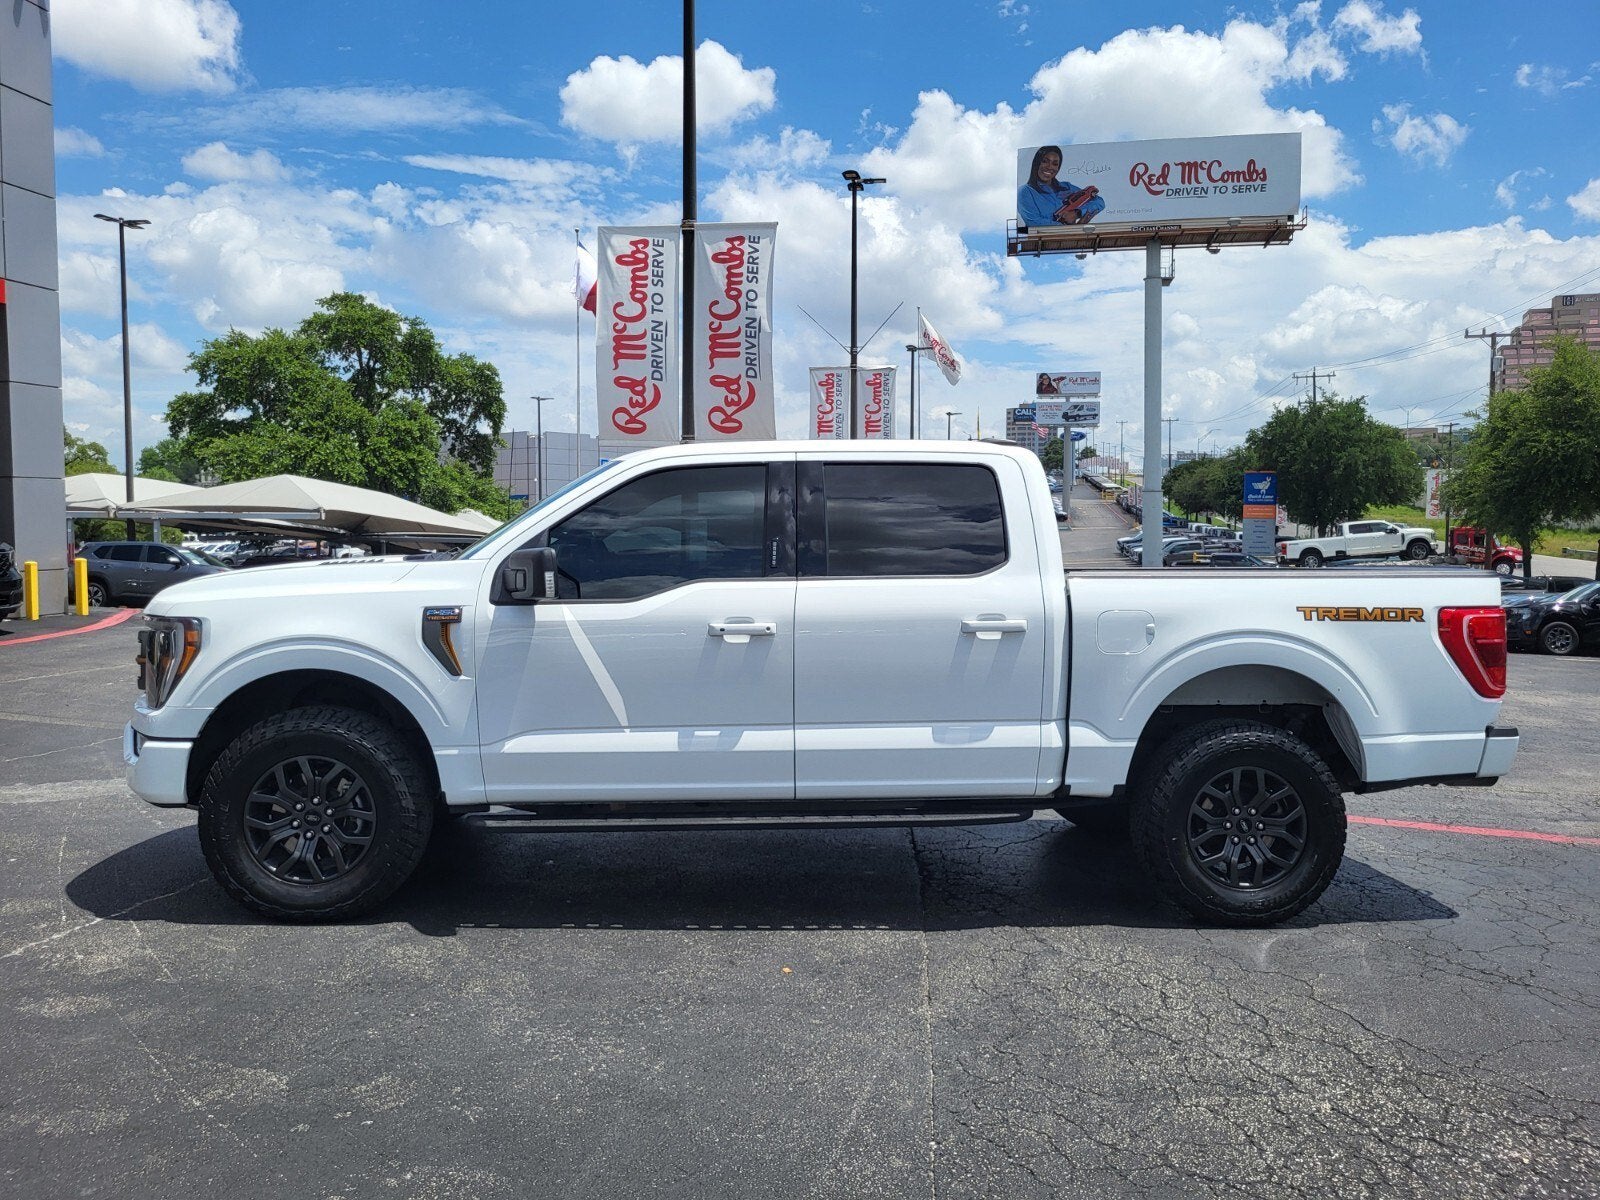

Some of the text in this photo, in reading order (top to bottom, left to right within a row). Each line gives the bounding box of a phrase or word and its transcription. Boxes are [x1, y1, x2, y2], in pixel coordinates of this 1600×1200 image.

[1129, 162, 1171, 196] Red
[1174, 158, 1268, 185] McCombs
[1166, 183, 1267, 197] DRIVEN TO SERVE
[612, 238, 661, 434] Red McCombs
[651, 239, 664, 382] DRIVEN TO SERVE
[708, 235, 756, 434] Red McCombs
[745, 235, 760, 379] DRIVEN TO SERVE
[817, 372, 835, 437] McCombs
[836, 400, 842, 410] TO
[865, 372, 882, 437] McCombs
[883, 399, 889, 411] TO
[1296, 606, 1425, 622] TREMOR
